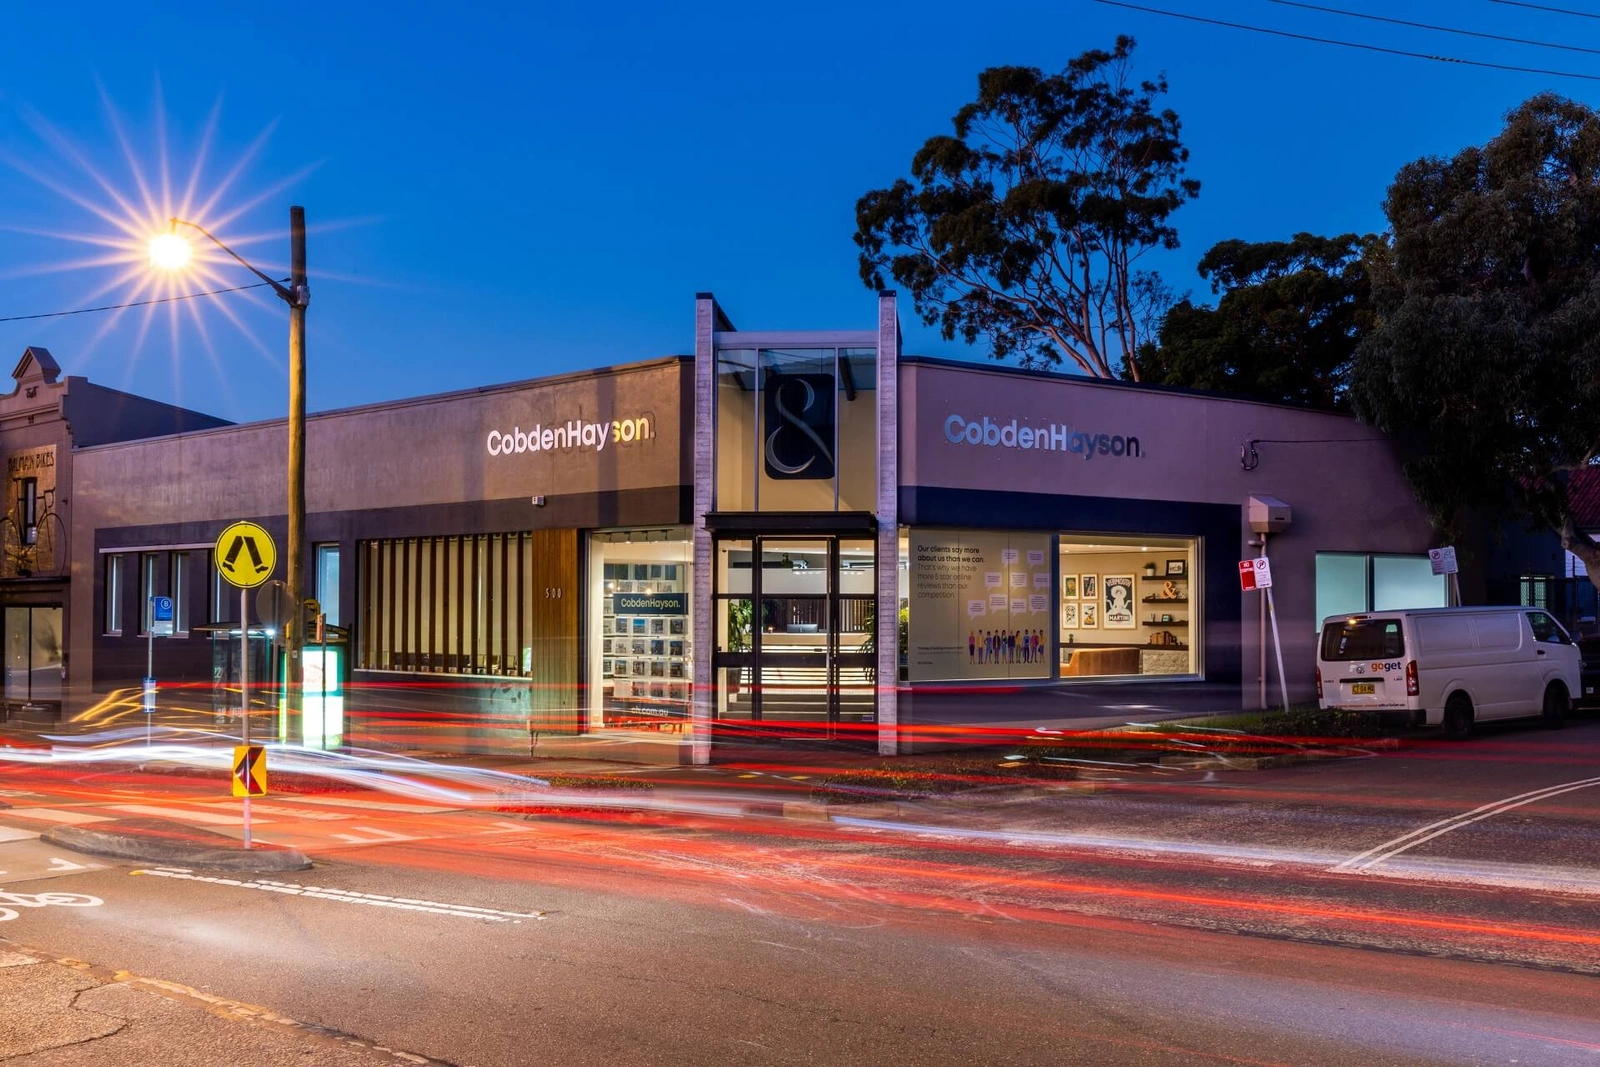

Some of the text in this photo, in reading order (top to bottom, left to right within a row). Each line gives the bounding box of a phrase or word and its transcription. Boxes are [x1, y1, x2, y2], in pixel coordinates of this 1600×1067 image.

[487, 416, 656, 456] CobdenHayson.
[945, 414, 1146, 460] CobdenHayson.
[36, 451, 54, 469] BIKES
[546, 588, 562, 598] 500
[621, 598, 680, 610] CobdenHayson.
[1371, 662, 1402, 672] goget
